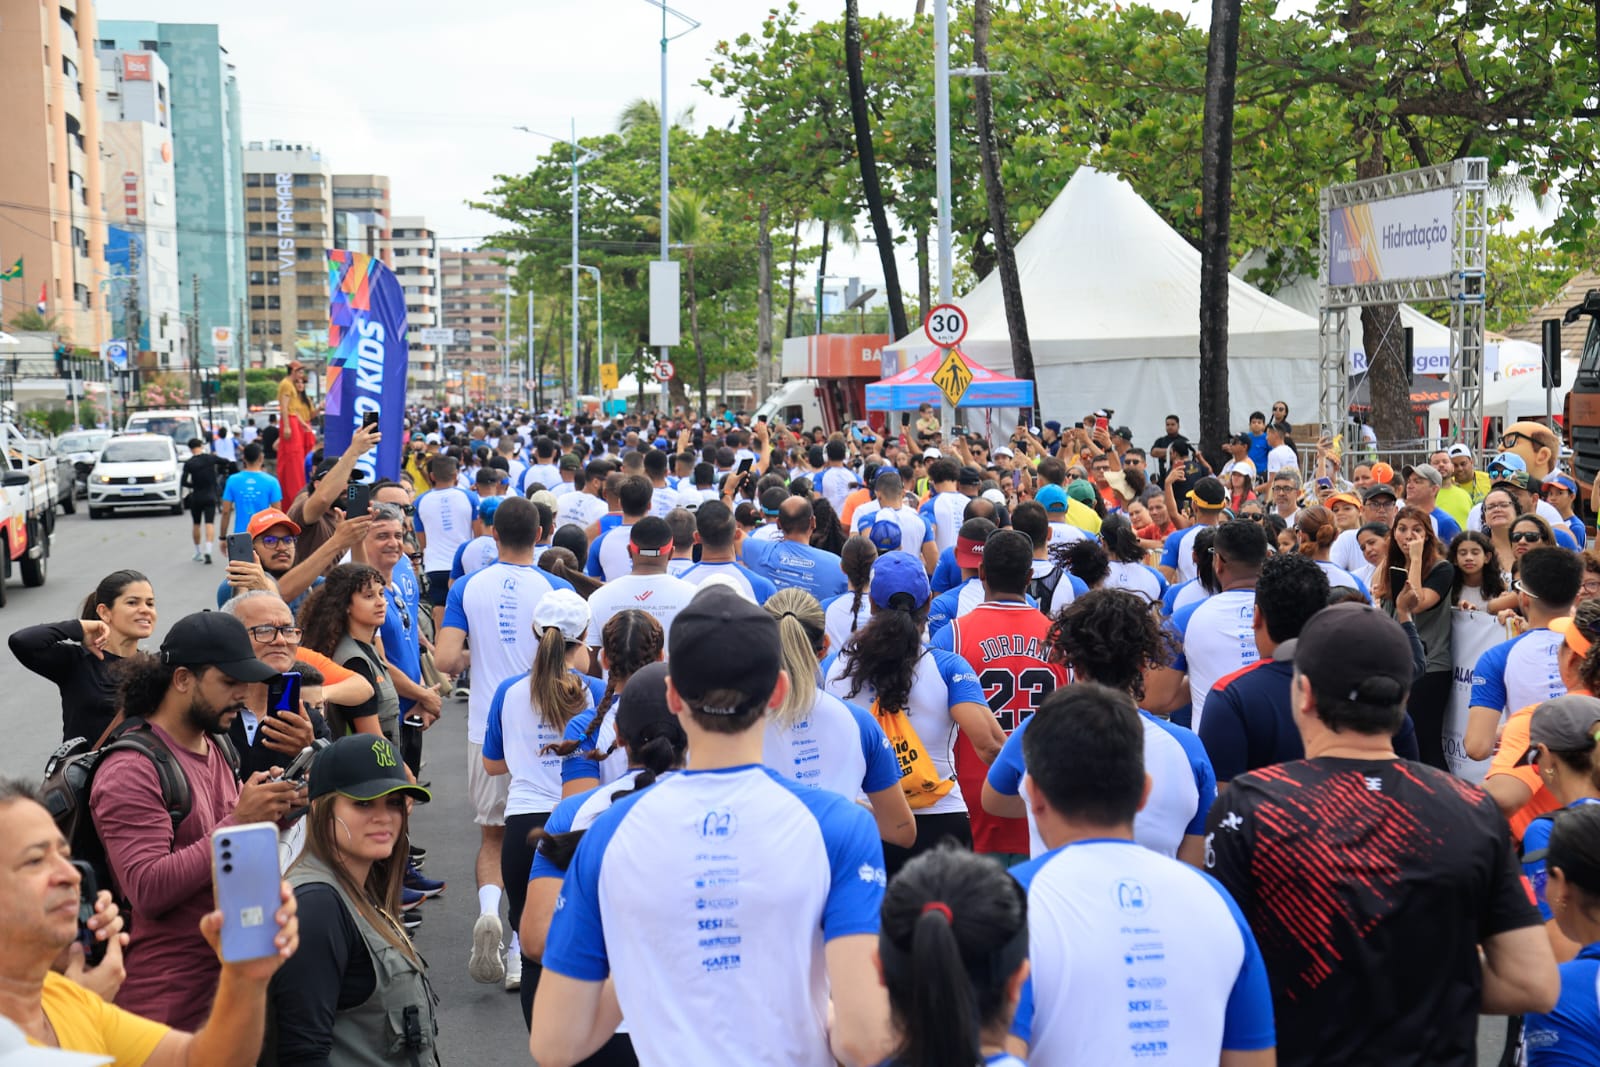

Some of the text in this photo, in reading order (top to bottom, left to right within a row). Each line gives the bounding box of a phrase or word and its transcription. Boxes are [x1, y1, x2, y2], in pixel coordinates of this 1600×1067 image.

[1382, 217, 1448, 250] Hidratação
[932, 314, 960, 333] 30
[356, 317, 385, 394] KIDS
[979, 634, 1052, 664] JORDAN
[978, 667, 1057, 732] 23
[698, 919, 723, 931] SESI
[1128, 1000, 1151, 1012] SESI
